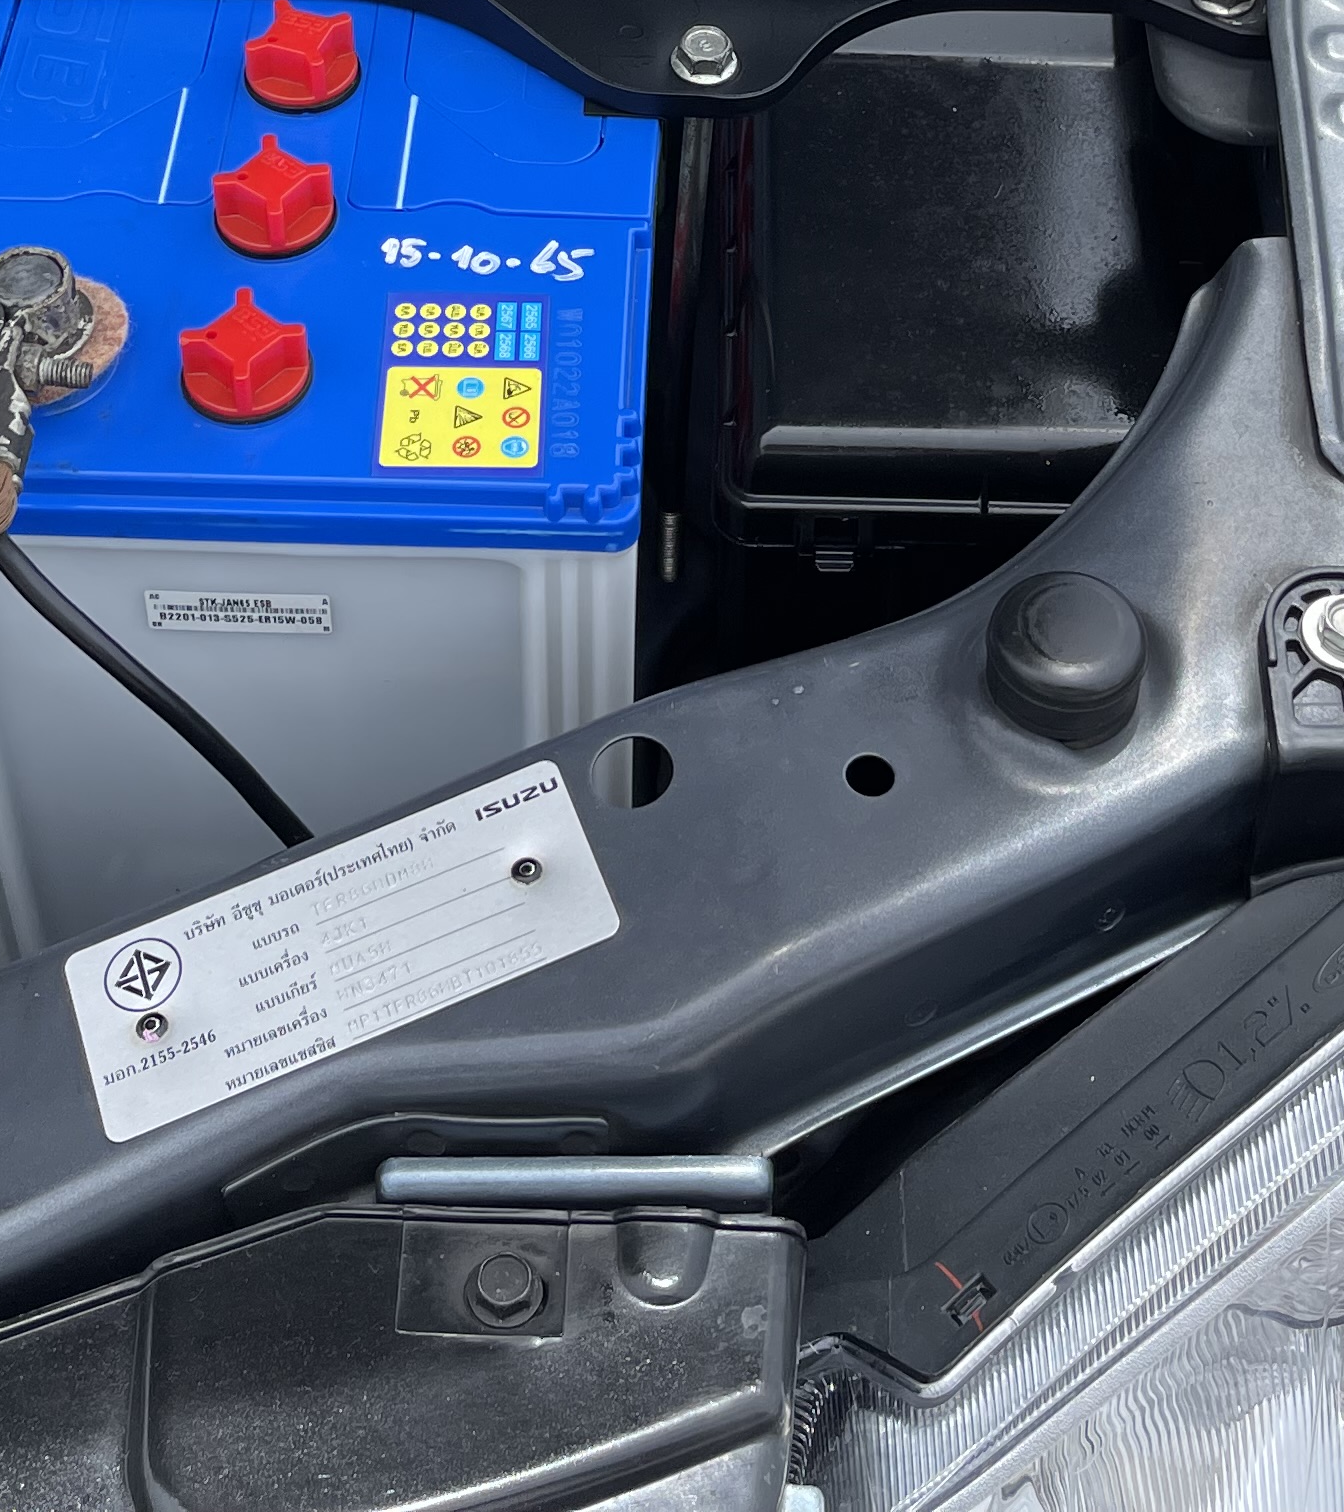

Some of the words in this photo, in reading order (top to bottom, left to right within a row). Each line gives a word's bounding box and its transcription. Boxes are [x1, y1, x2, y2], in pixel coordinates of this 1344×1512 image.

[381, 237, 596, 282] 15-10-65
[500, 303, 514, 329] 2567
[525, 303, 539, 330] 2565
[498, 333, 512, 359] 2568
[523, 333, 537, 360] 2566
[408, 409, 421, 424] Pb
[474, 776, 560, 822] ISUZU
[182, 913, 227, 942] บริษัท
[418, 818, 458, 844] จำกัด
[251, 922, 301, 951] แบบรถ
[237, 948, 310, 989] แบบเครื่อง
[254, 971, 320, 1014] แบบเกียร์
[223, 1004, 329, 1060] หมายเลขเครื่อง
[102, 1028, 218, 1087] มอก.2155-2546
